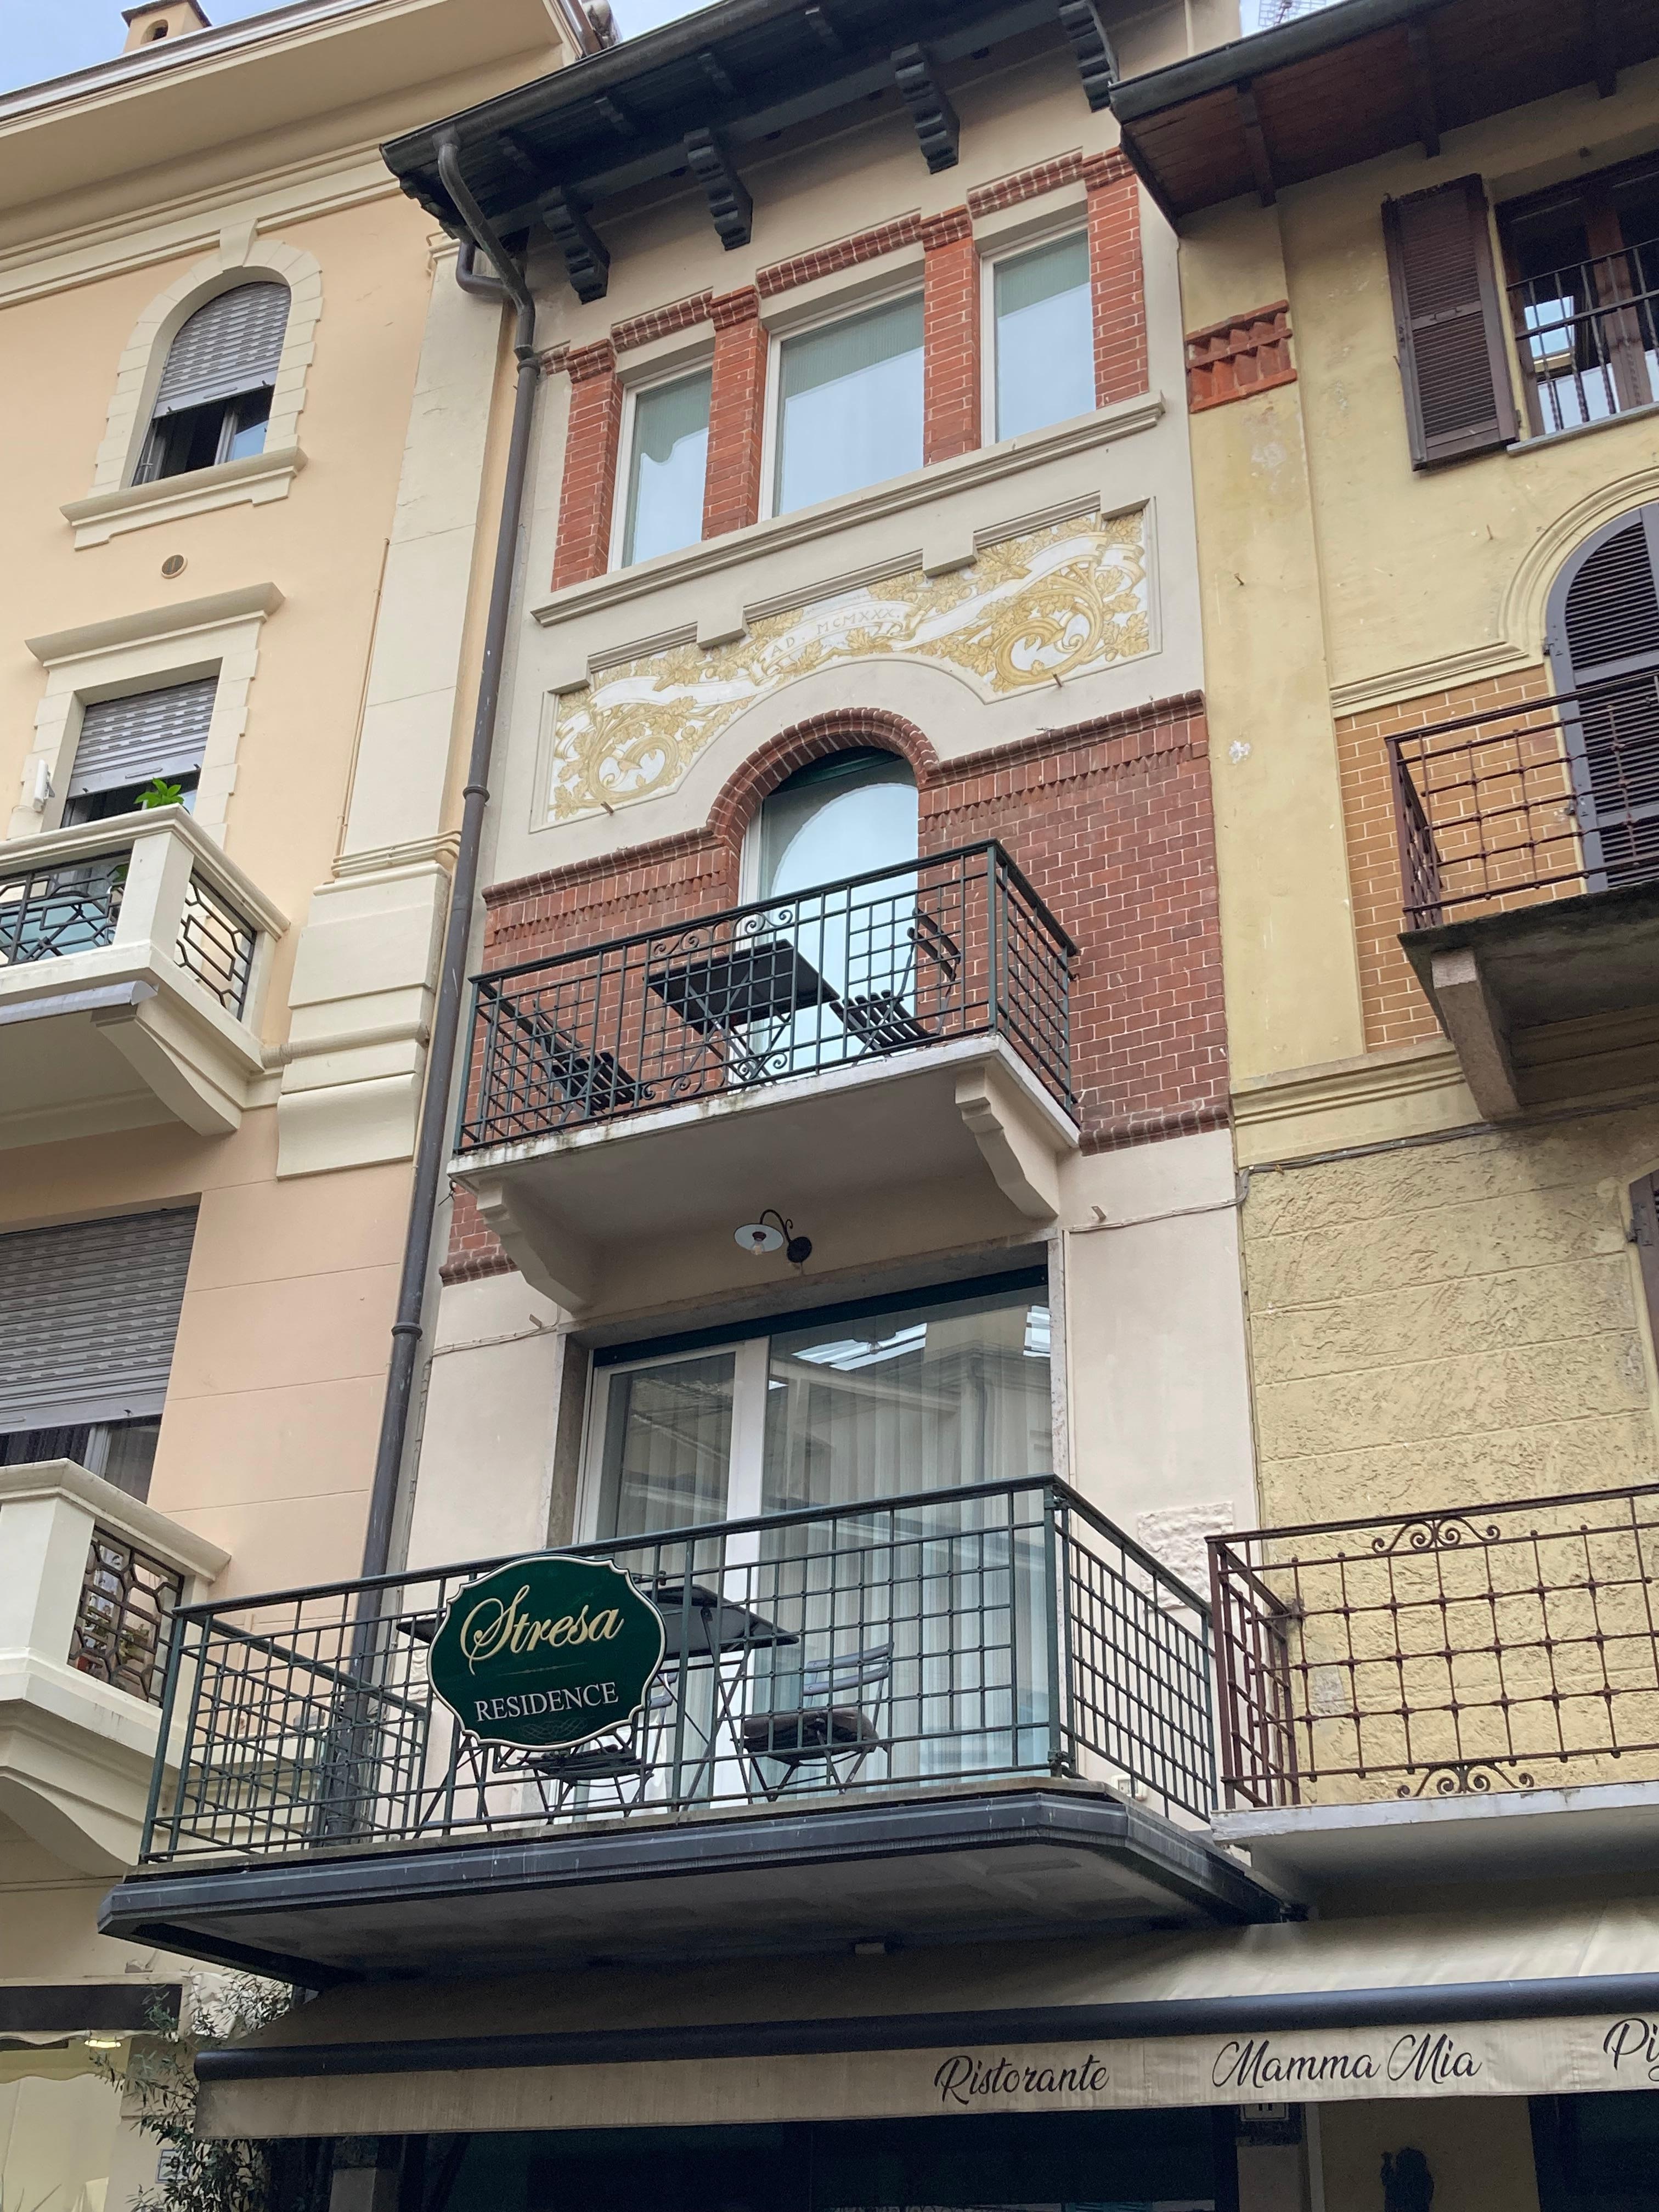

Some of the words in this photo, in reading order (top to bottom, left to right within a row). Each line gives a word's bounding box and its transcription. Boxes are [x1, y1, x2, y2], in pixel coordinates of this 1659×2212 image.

[460, 1584, 624, 1675] Stresa
[474, 1682, 619, 1722] RESIDENCE
[934, 2054, 1109, 2105] Ristorante
[1212, 2039, 1381, 2089] Mamma
[1387, 2033, 1482, 2084] Mia
